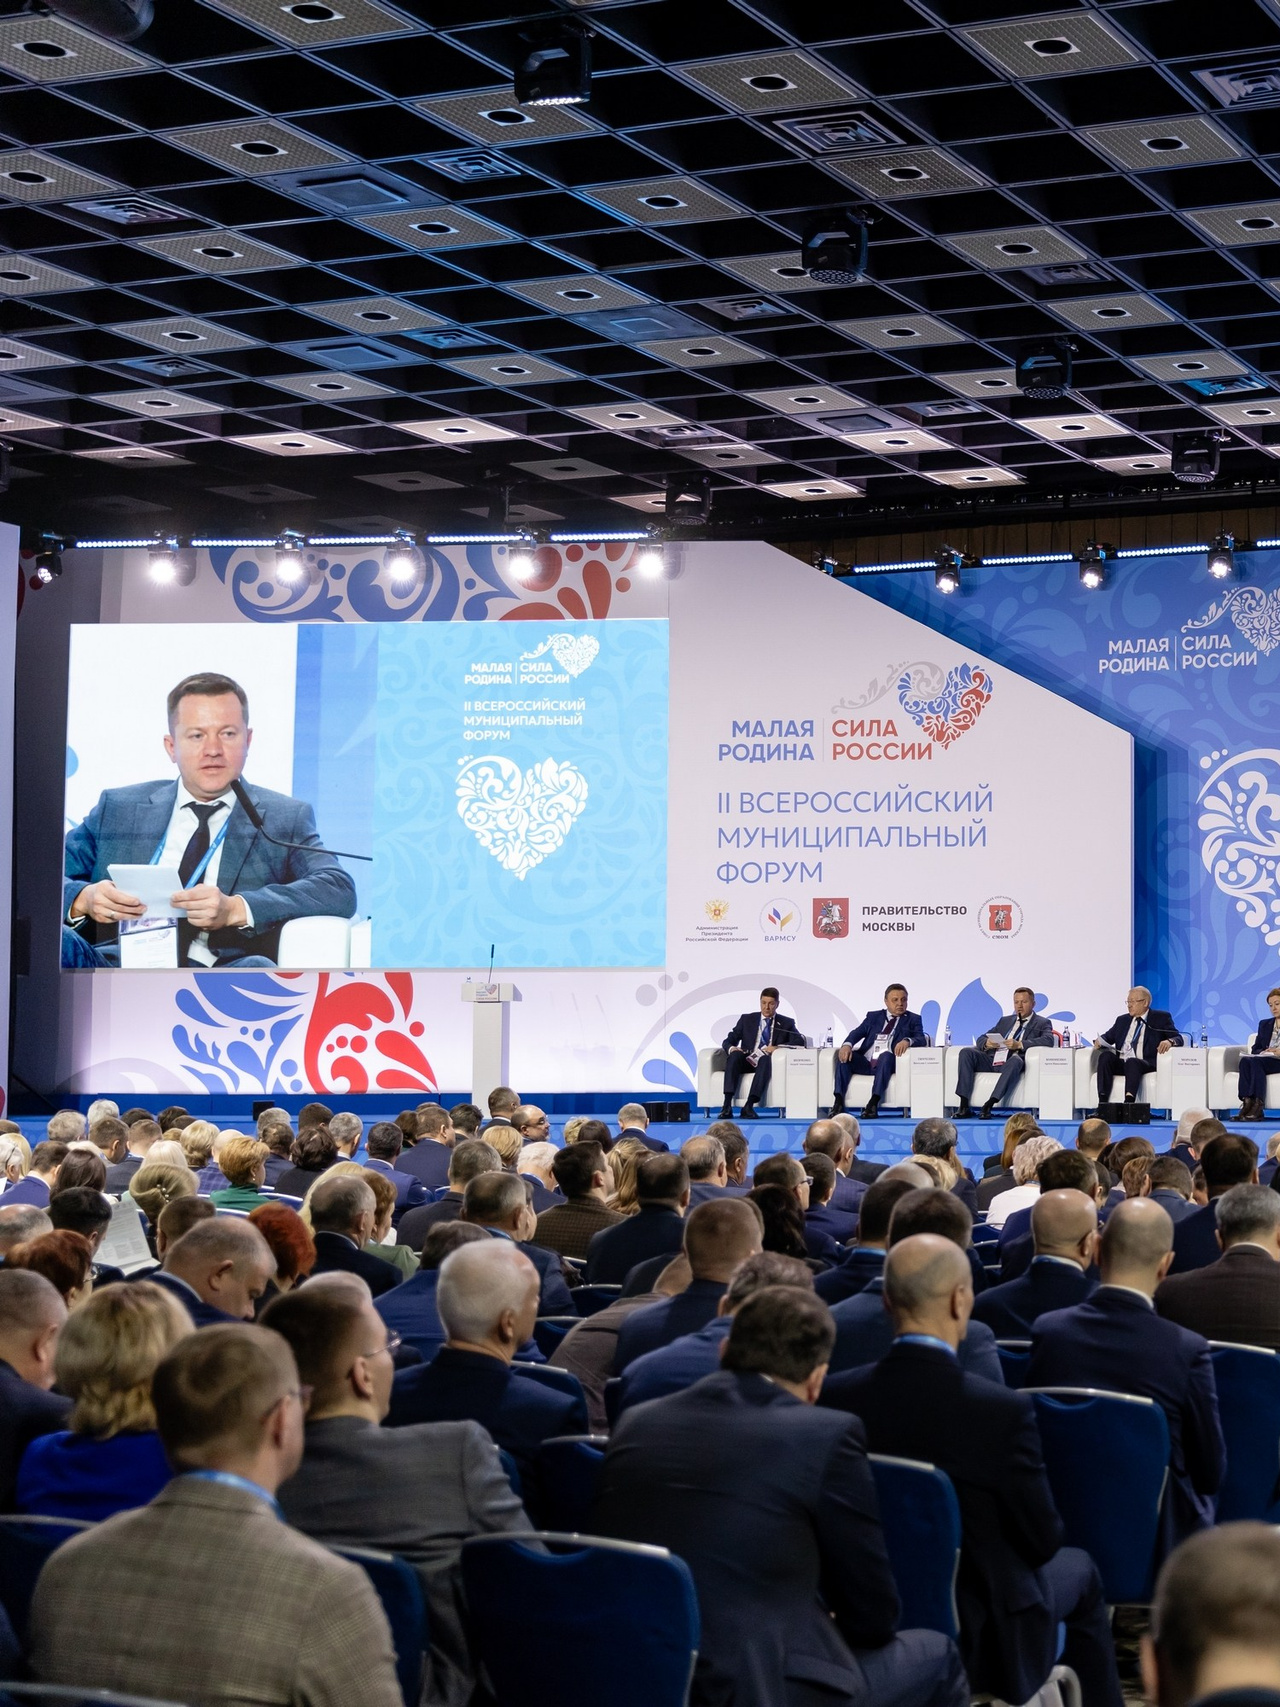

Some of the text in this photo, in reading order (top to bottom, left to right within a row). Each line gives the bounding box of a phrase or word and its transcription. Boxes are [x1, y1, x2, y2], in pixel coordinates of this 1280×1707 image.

[1109, 638, 1169, 654] МАЛАЯ
[1182, 634, 1232, 650] СИЛА
[471, 662, 512, 672] МАЛАЯ
[520, 662, 553, 672] СИЛА
[1099, 656, 1170, 674] РОДИНА
[1182, 652, 1258, 670] РОССИИ
[464, 674, 512, 685] РОДИНА
[520, 674, 570, 684] РОССИИ
[464, 698, 586, 712] II ВСЕРОССИЙСКИЙ
[464, 712, 582, 728] МУНИЦИПАЛЬНЫЙ
[832, 719, 898, 737] СИЛА
[463, 730, 510, 741] ФОРУМ
[732, 720, 814, 738] МАЛАЯ
[718, 743, 815, 763] РОДИНА
[832, 742, 932, 760] РОССИИ
[718, 783, 993, 814] II ВСЕРОССИЙСКИЙ
[718, 818, 987, 853] МУНИЦИПАЛЬНЫЙ
[716, 861, 823, 884] ФОРУМ
[862, 905, 967, 916] ПРАВИТЕЛЬСТВО
[862, 922, 915, 932] МОСКВЫ
